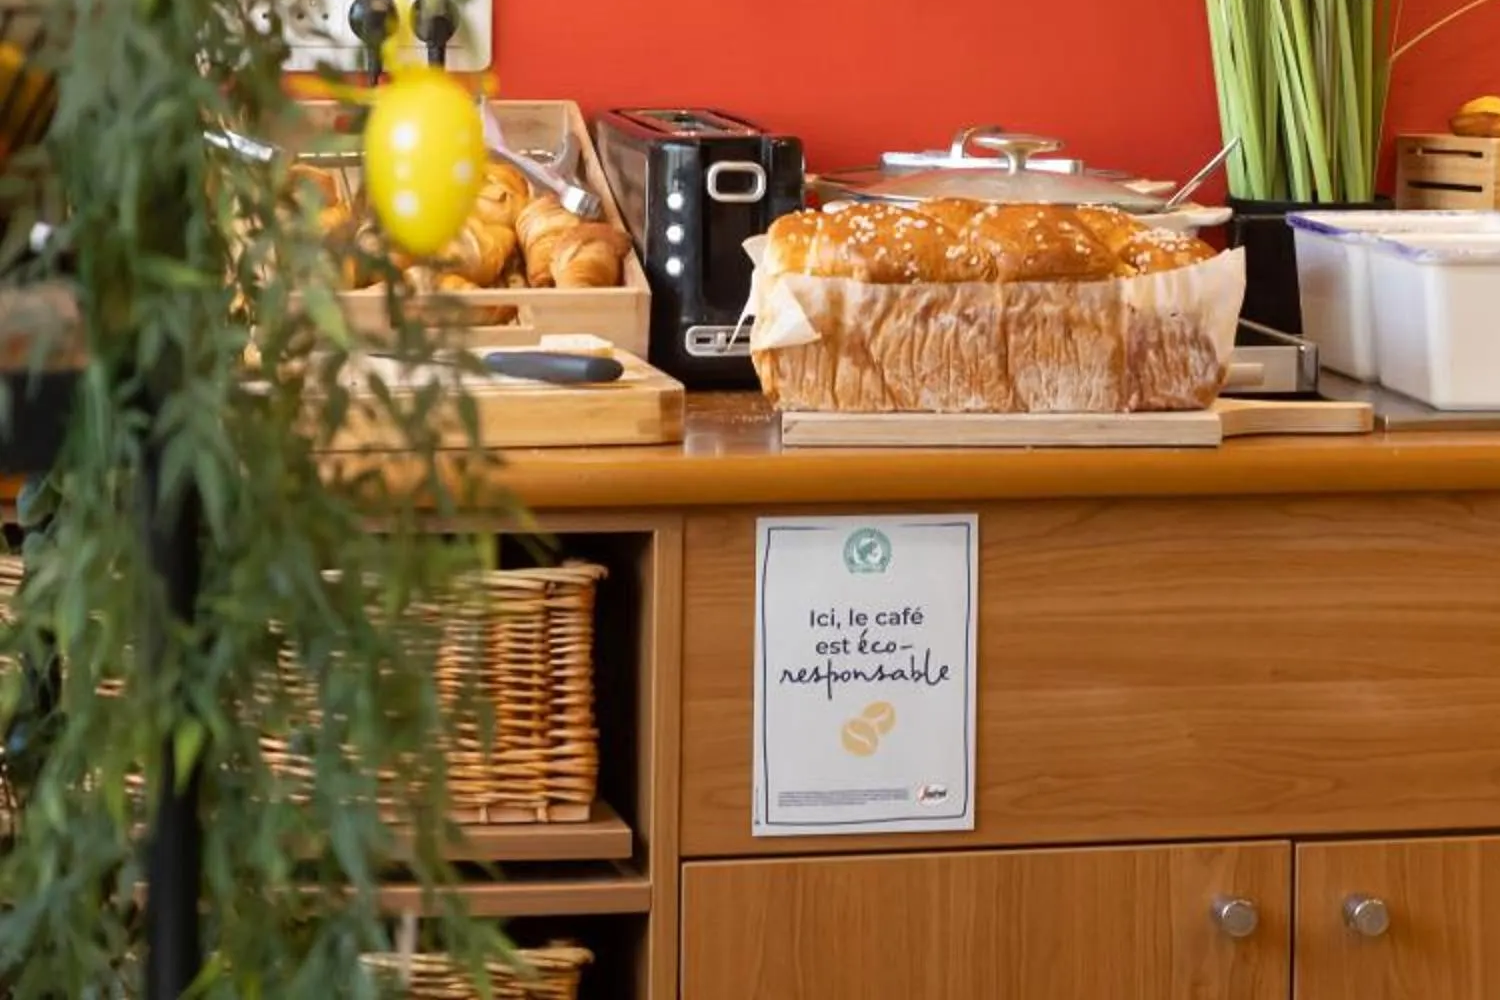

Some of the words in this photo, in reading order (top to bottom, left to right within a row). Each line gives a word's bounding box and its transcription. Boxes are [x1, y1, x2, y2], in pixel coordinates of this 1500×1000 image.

[810, 607, 841, 629] Ici,
[849, 607, 869, 627] le
[875, 605, 924, 626] café
[815, 638, 850, 655] est
[857, 628, 914, 655] éco-
[779, 648, 951, 700] responsable
